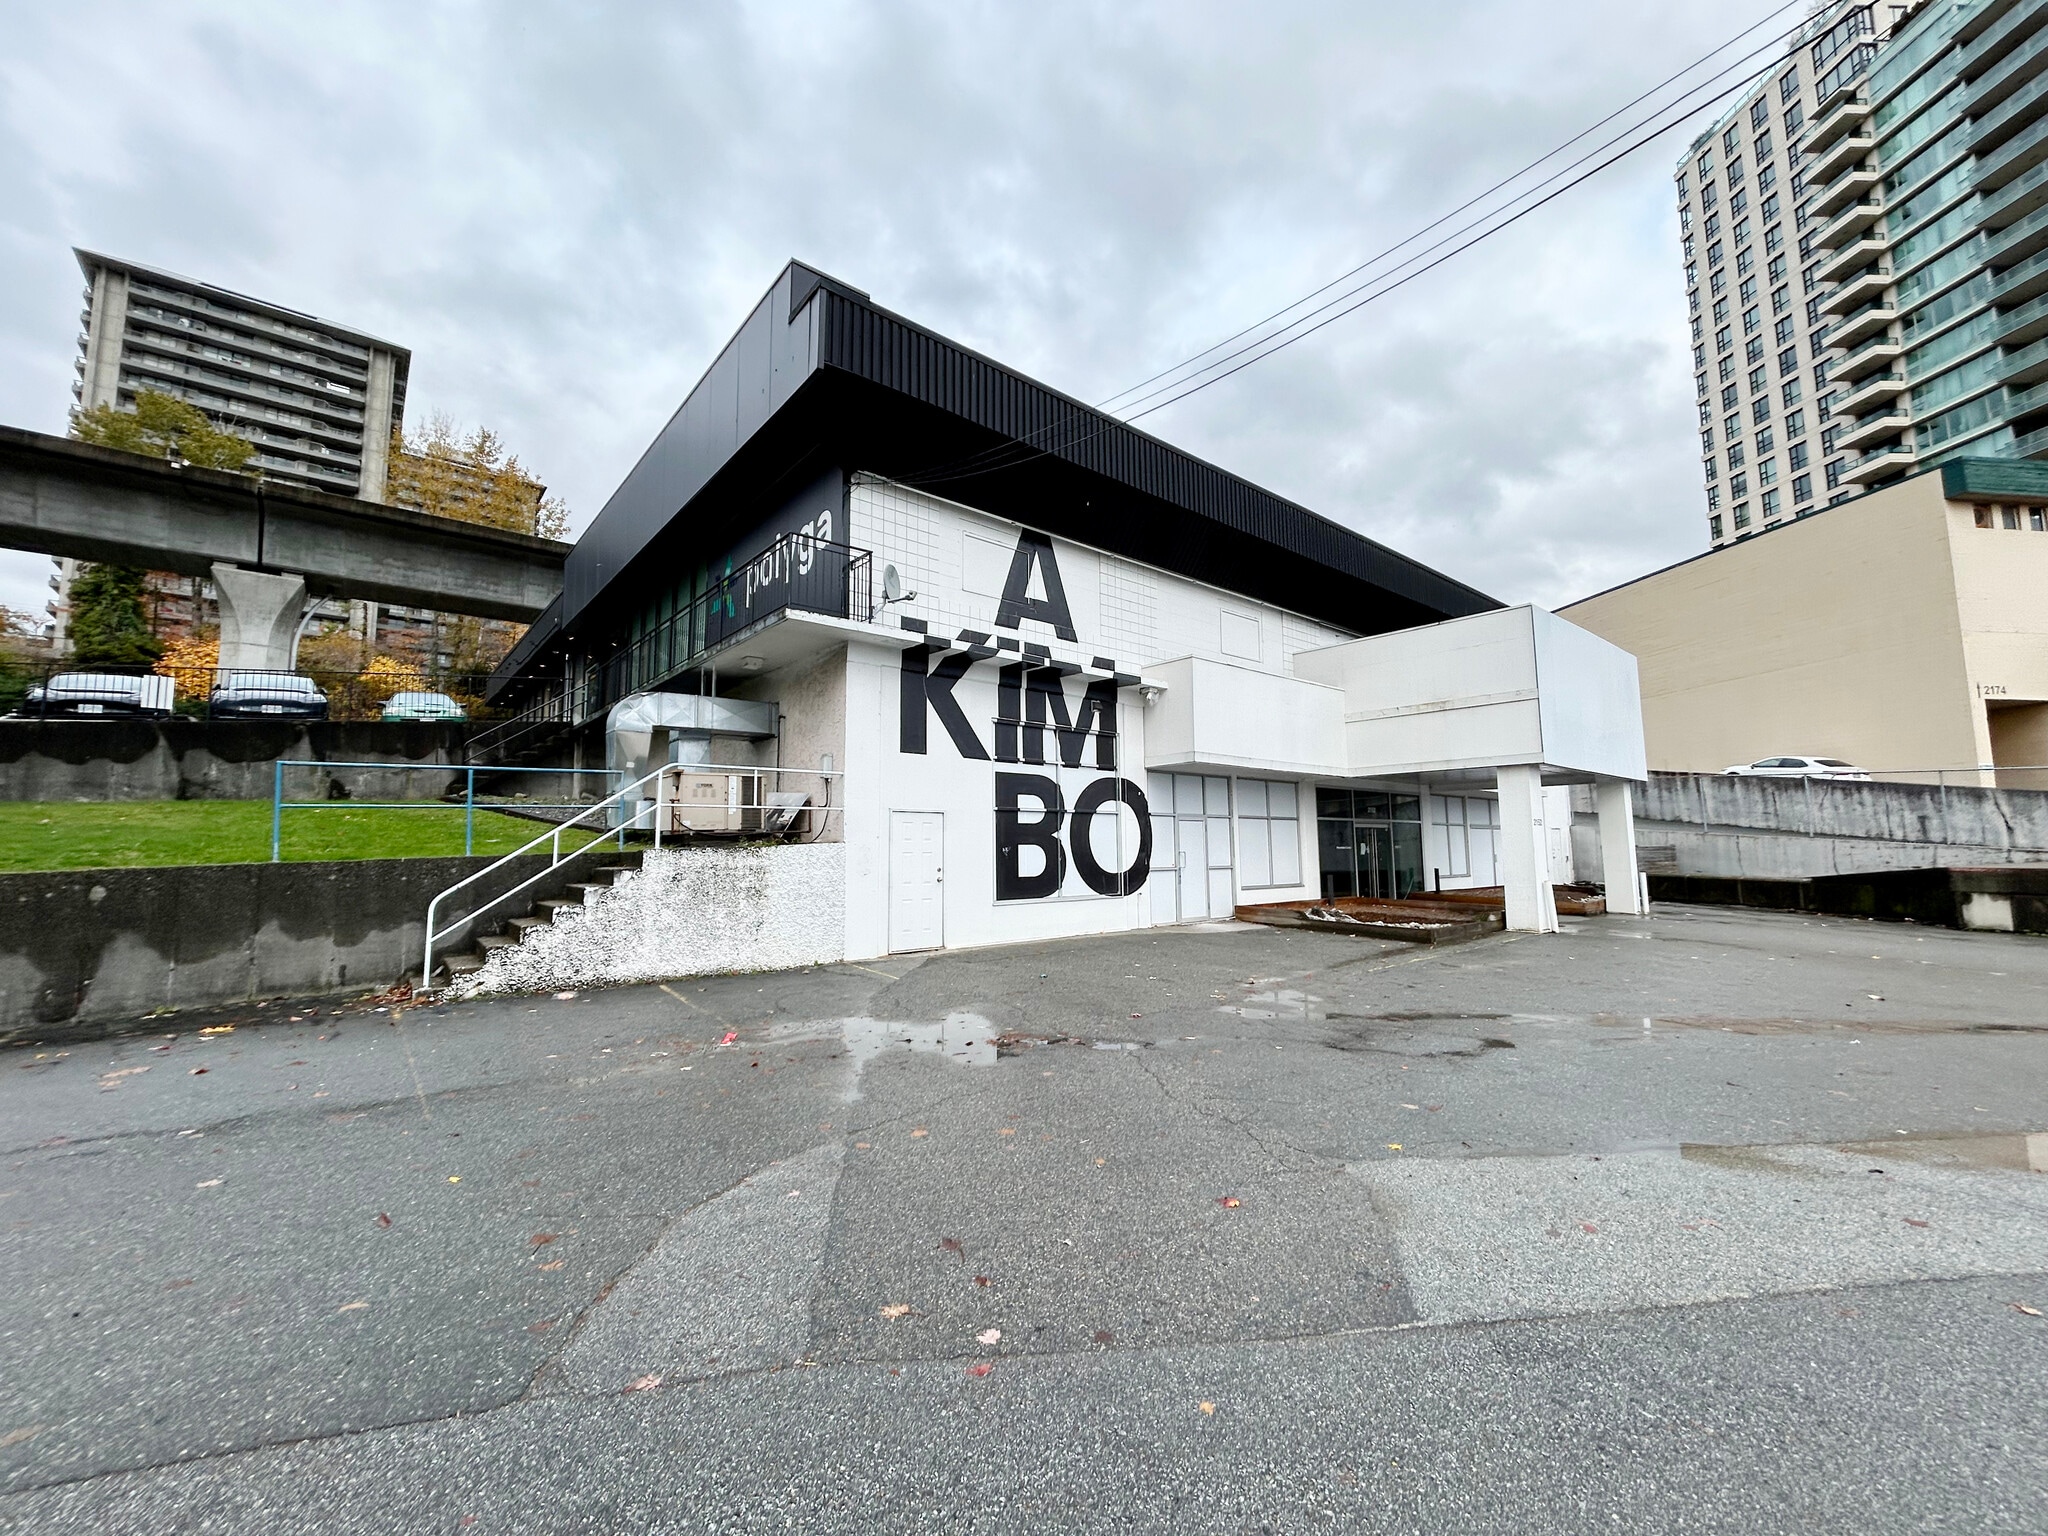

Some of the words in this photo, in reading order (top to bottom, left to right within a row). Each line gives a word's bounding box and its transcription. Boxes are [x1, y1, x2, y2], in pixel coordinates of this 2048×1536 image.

[745, 510, 832, 608] polyga
[994, 527, 1078, 643] A
[900, 615, 1141, 771] KIM
[1984, 685, 2006, 695] 2174
[995, 772, 1152, 900] BO
